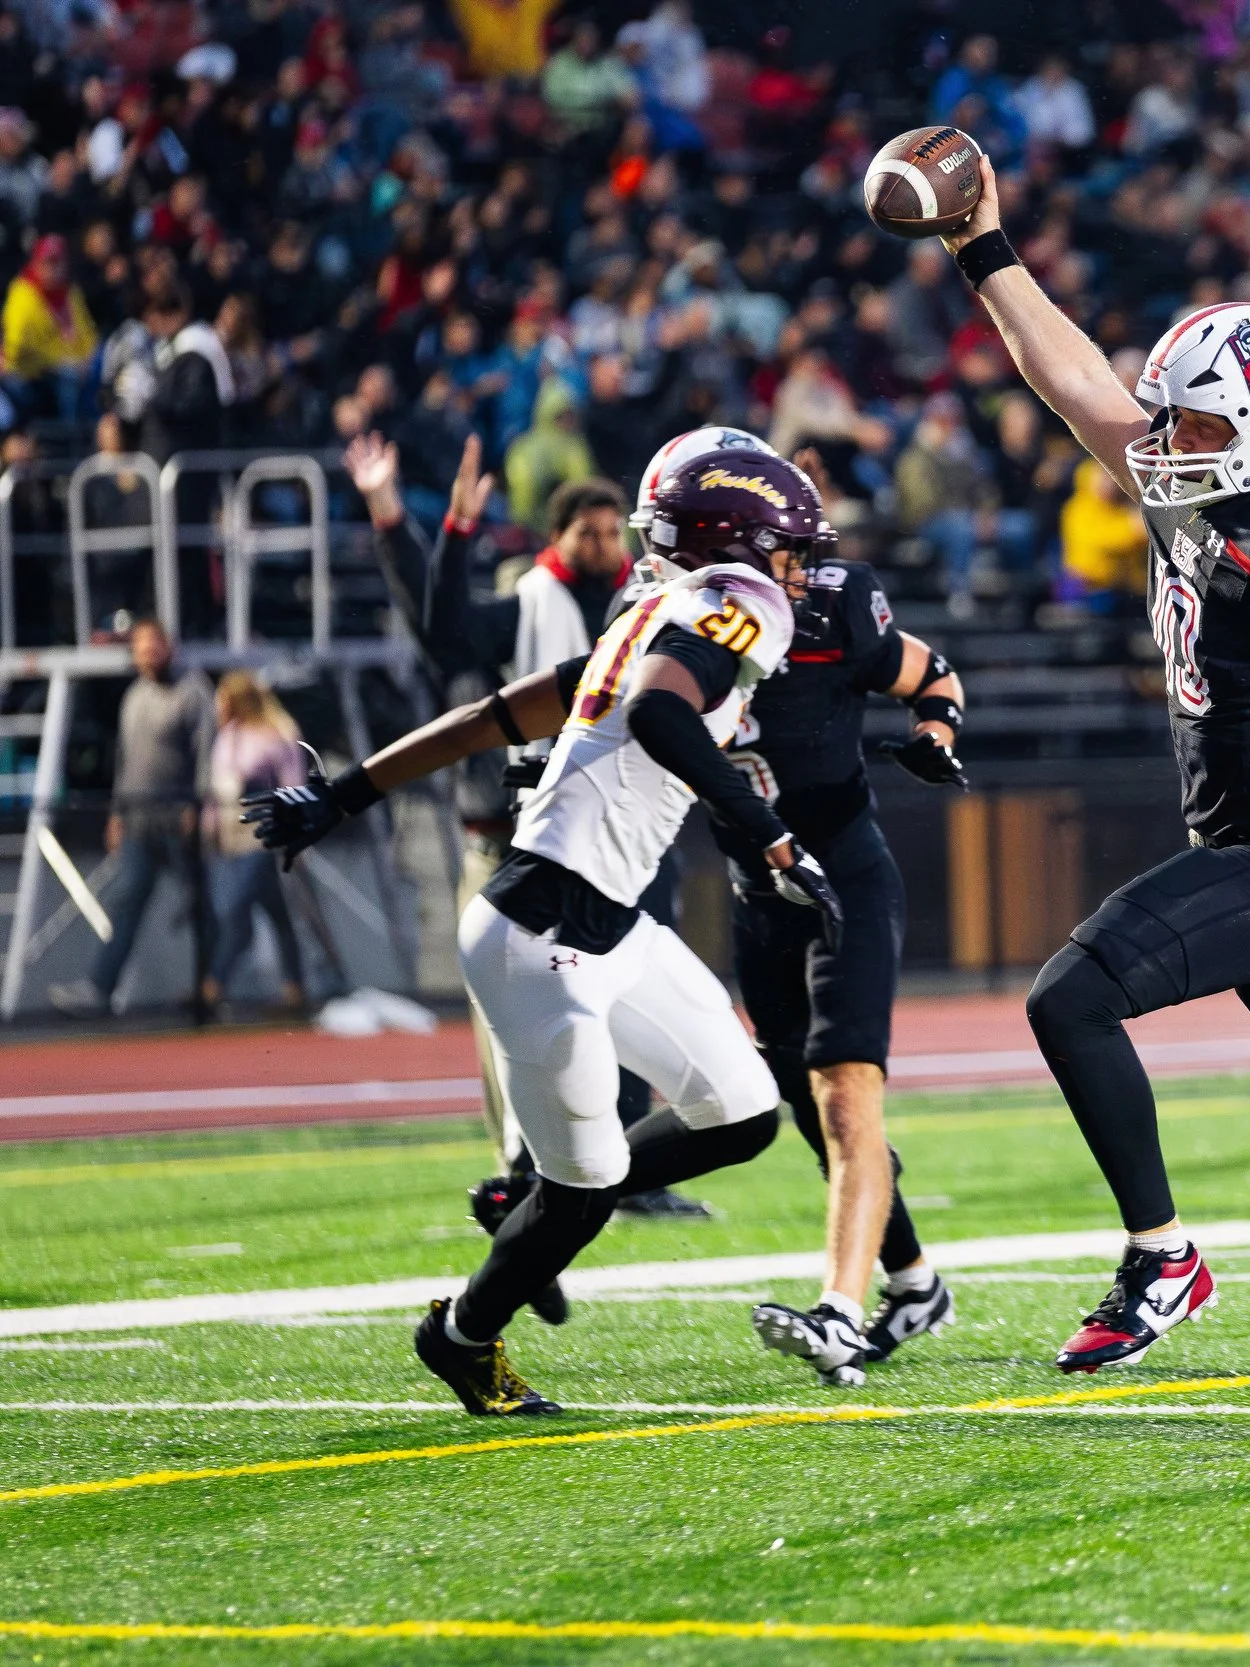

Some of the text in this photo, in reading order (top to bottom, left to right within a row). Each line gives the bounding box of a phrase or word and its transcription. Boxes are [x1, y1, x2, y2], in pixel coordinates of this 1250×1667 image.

[937, 147, 972, 174] Wilson
[699, 468, 789, 510] Huskies
[693, 598, 761, 657] 20
[1151, 552, 1213, 717] 10
